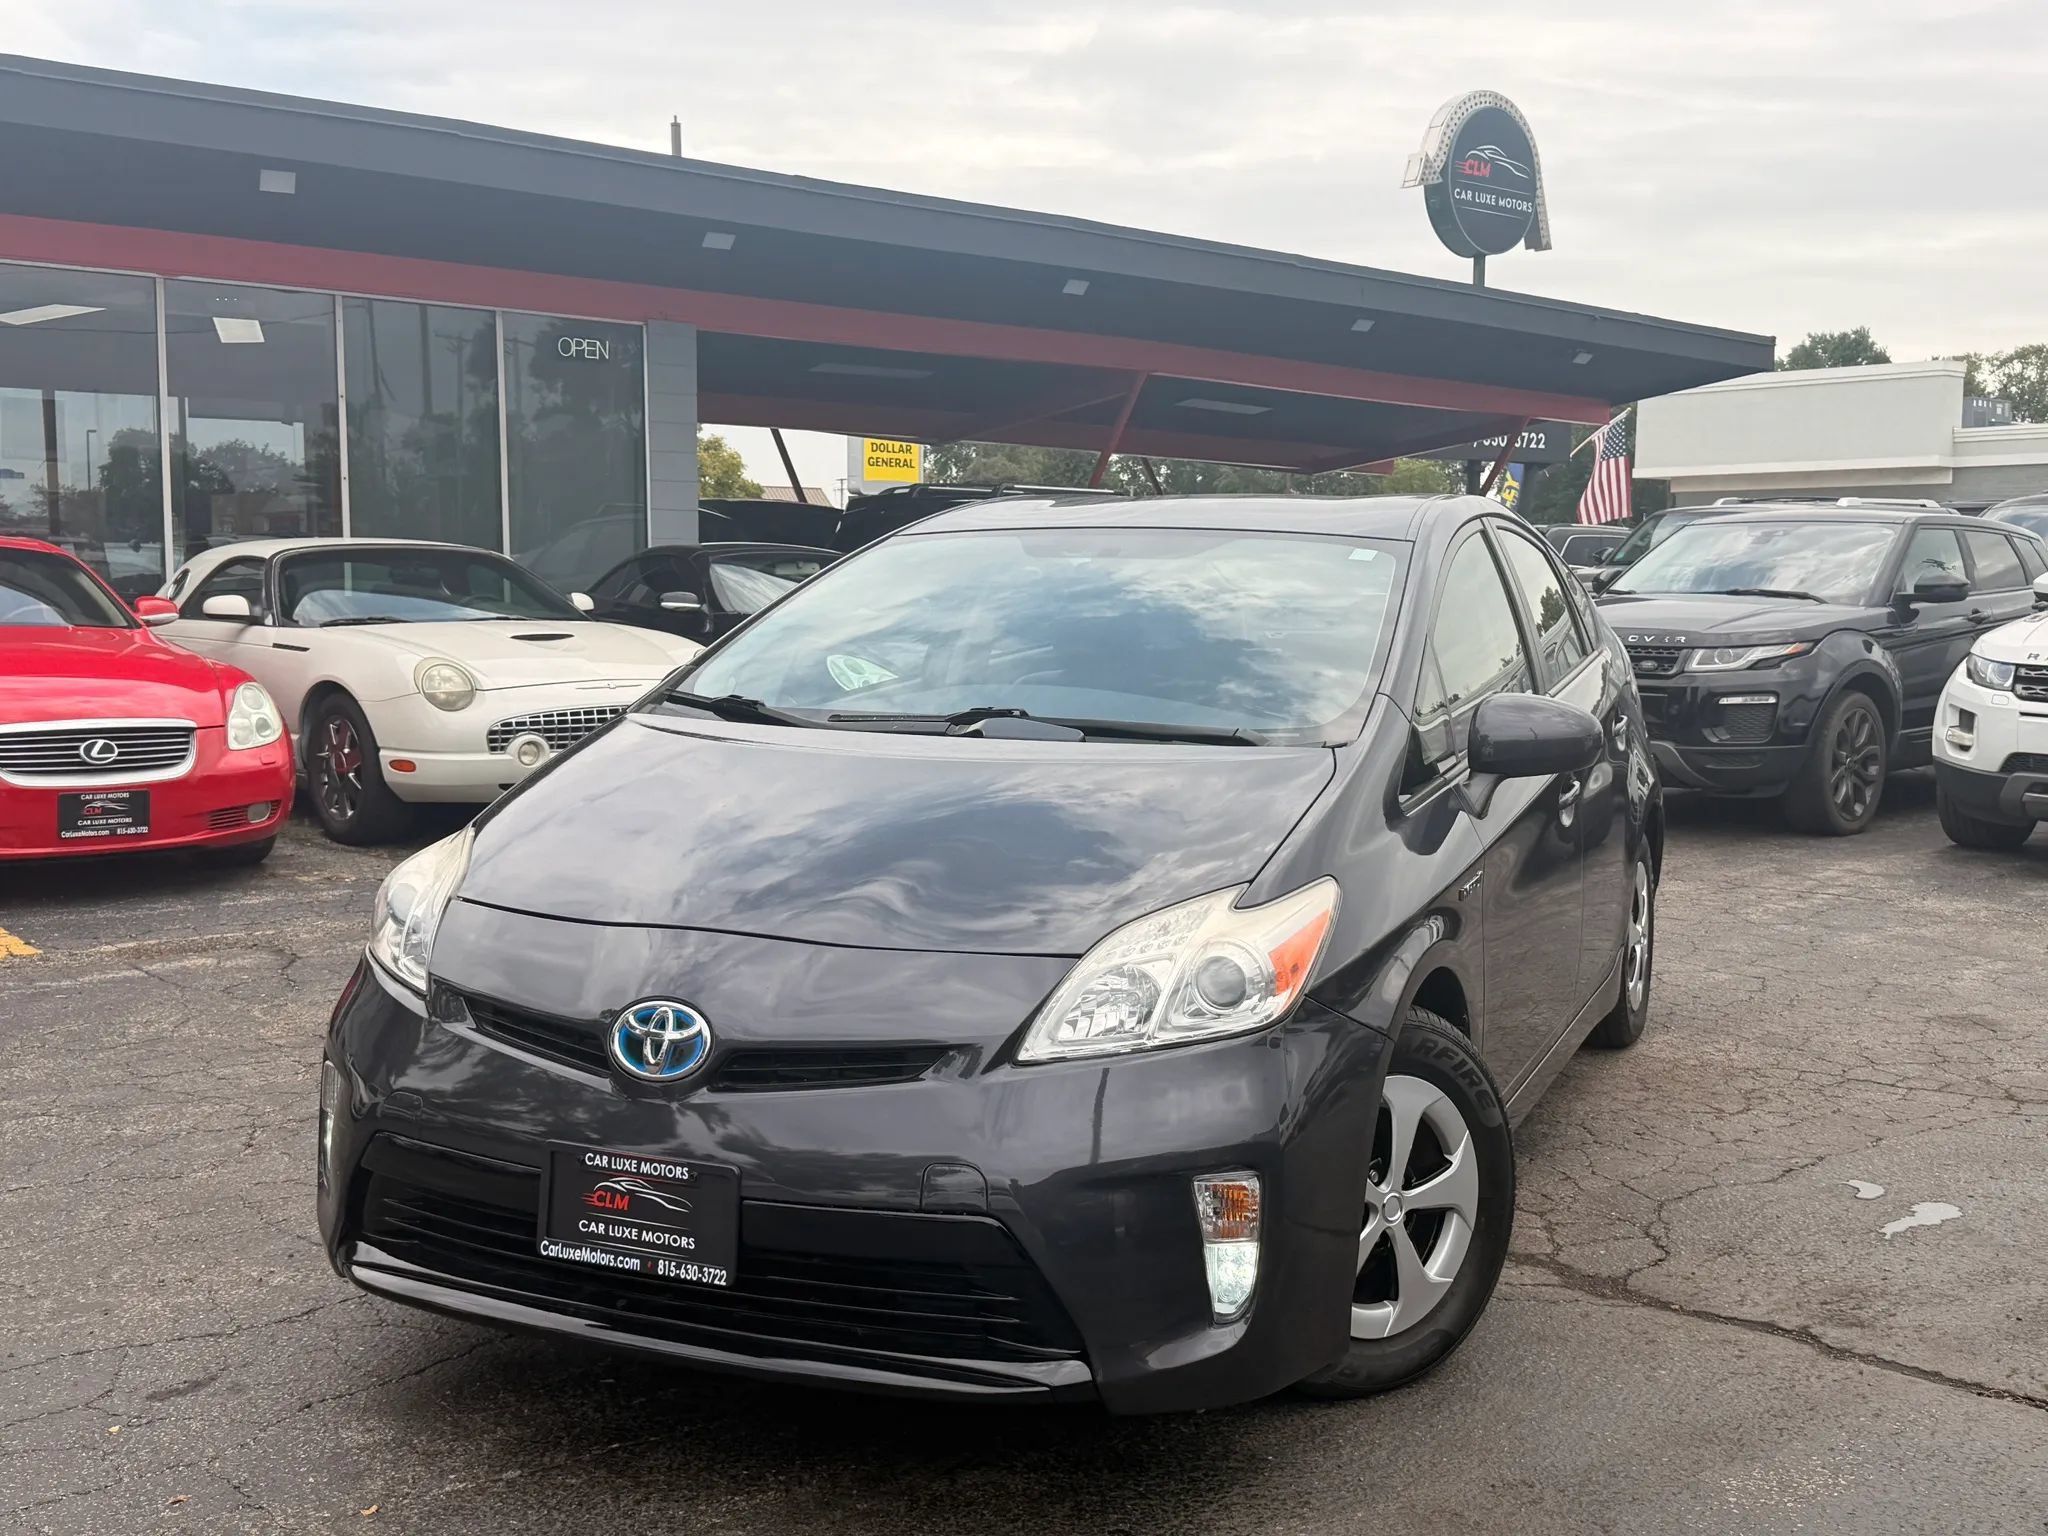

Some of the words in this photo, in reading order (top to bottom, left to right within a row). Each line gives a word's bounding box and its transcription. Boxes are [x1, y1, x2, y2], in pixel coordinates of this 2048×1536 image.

[1463, 160, 1491, 177] CLM
[1454, 188, 1473, 201] CAR
[1475, 191, 1497, 206] LUXE
[1498, 196, 1533, 213] MOTORS
[558, 336, 609, 360] OPEN
[870, 442, 913, 455] DOLLAR
[867, 456, 916, 469] GENERAL
[61, 829, 110, 838] CarLuxeMotors.com
[585, 1152, 609, 1169] CAR
[611, 1156, 638, 1173] LUXE
[639, 1161, 690, 1180] MOTORS
[593, 1189, 631, 1211] CLM
[578, 1219, 606, 1235] CAR
[608, 1225, 639, 1241] LUXE
[641, 1231, 696, 1250] MOTORS
[540, 1240, 641, 1272] CarLuxeMotors.com
[657, 1259, 727, 1286] 815-630-3722
